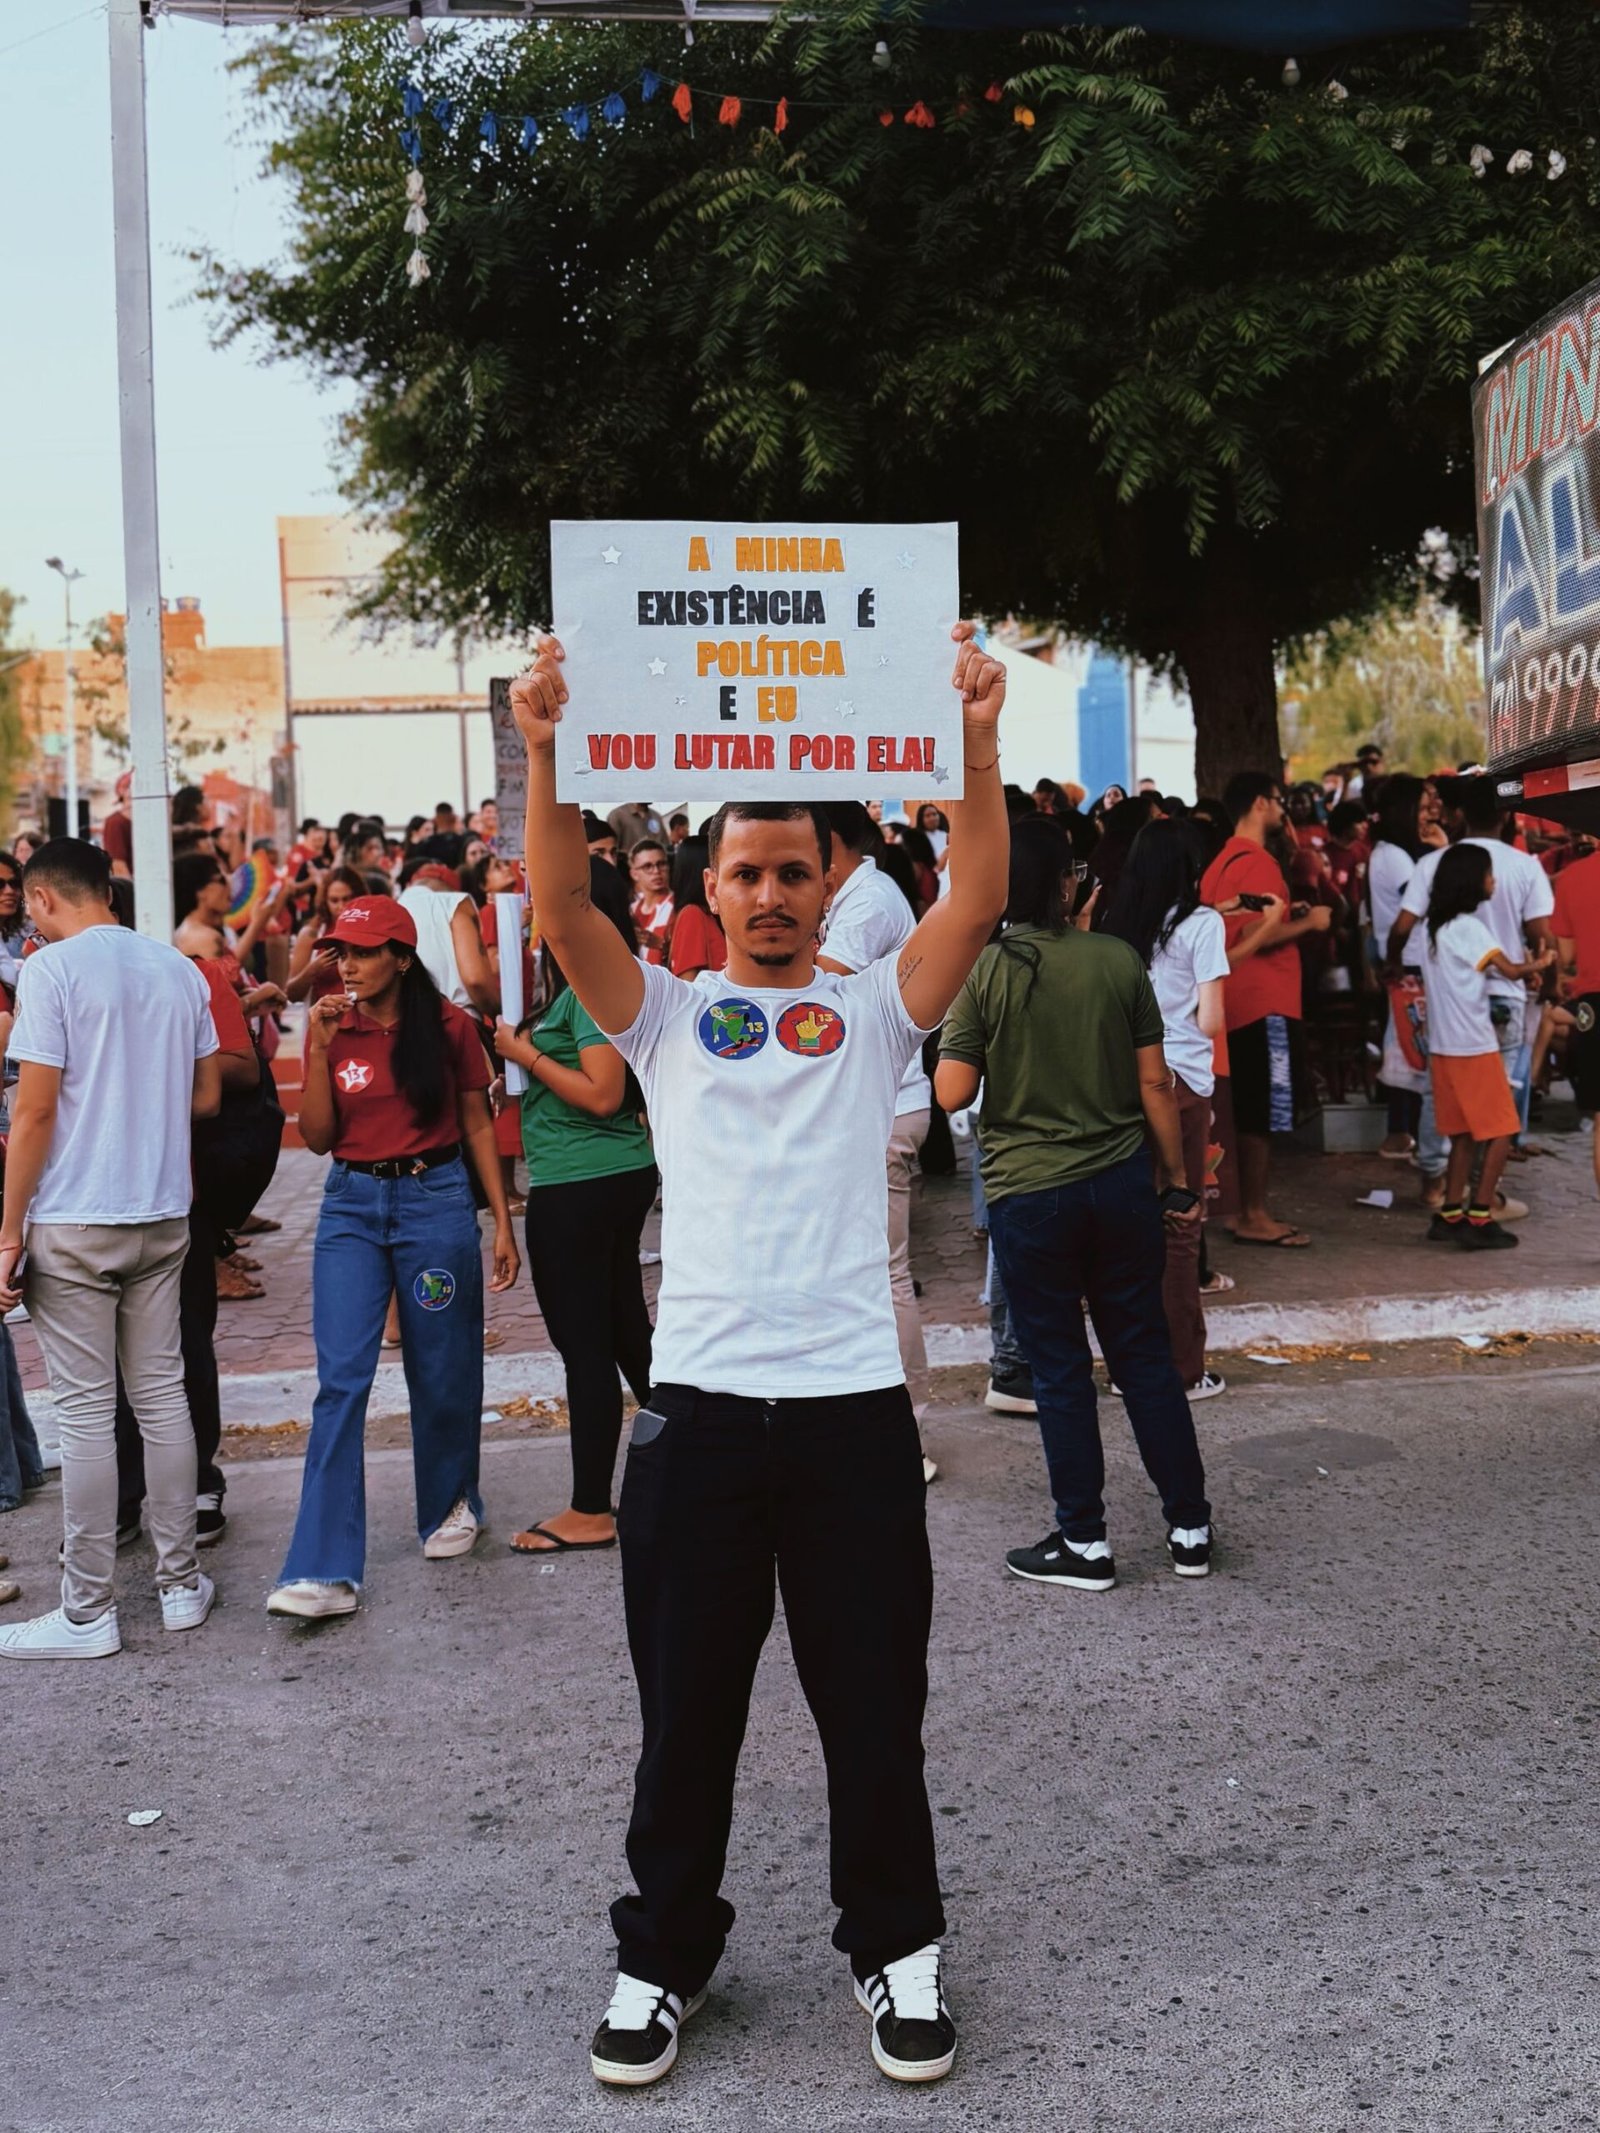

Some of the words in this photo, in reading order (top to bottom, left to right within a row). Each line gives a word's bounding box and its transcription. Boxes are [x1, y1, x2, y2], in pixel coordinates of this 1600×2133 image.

[688, 536, 711, 571] A
[736, 537, 845, 572] MINHA
[637, 584, 826, 626] EXISTÊNCIA
[857, 588, 876, 628] É
[697, 634, 846, 677] POLÍTICA
[719, 686, 738, 721] E
[757, 686, 799, 722] EU
[588, 733, 656, 770] VOU
[674, 734, 775, 771] LUTAR
[789, 734, 855, 771] POR
[867, 735, 936, 773] ELA!
[746, 1021, 765, 1033] 13
[817, 1013, 833, 1022] 13
[346, 1068, 361, 1082] 13
